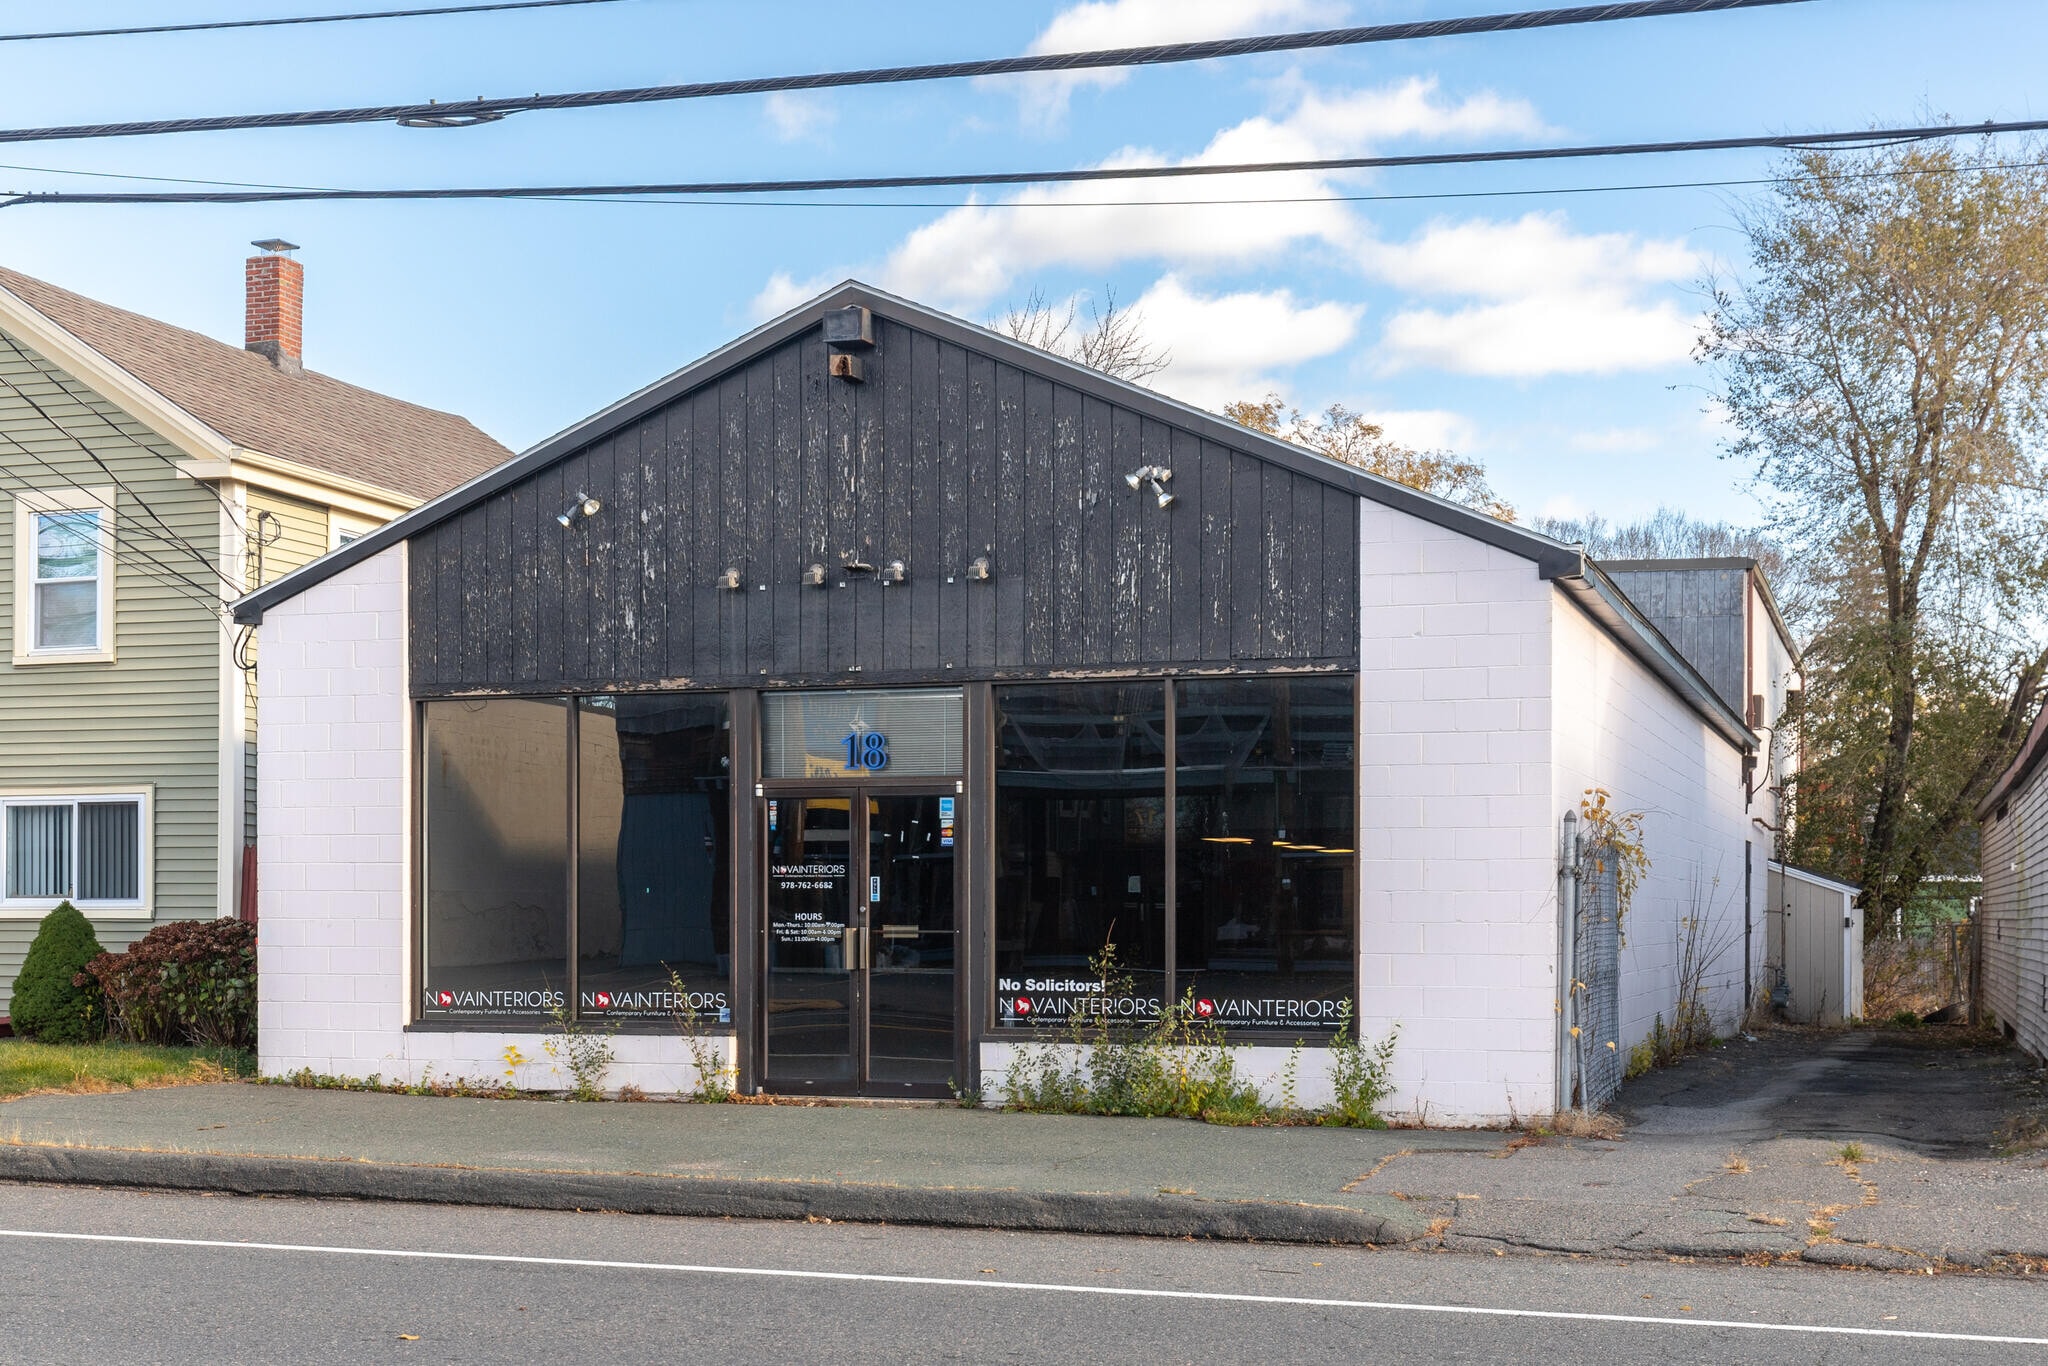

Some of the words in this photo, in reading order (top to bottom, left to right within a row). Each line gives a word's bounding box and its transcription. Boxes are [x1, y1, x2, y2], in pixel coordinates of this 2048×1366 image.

[840, 731, 888, 771] 18
[780, 881, 833, 889] 978-762-6682
[794, 912, 823, 921] HOURS
[999, 978, 1021, 991] No
[1025, 978, 1106, 992] Solicitors!
[448, 1008, 484, 1016] Contemporary
[606, 1009, 643, 1017] Contemporary
[1251, 1018, 1279, 1026] Furniture
